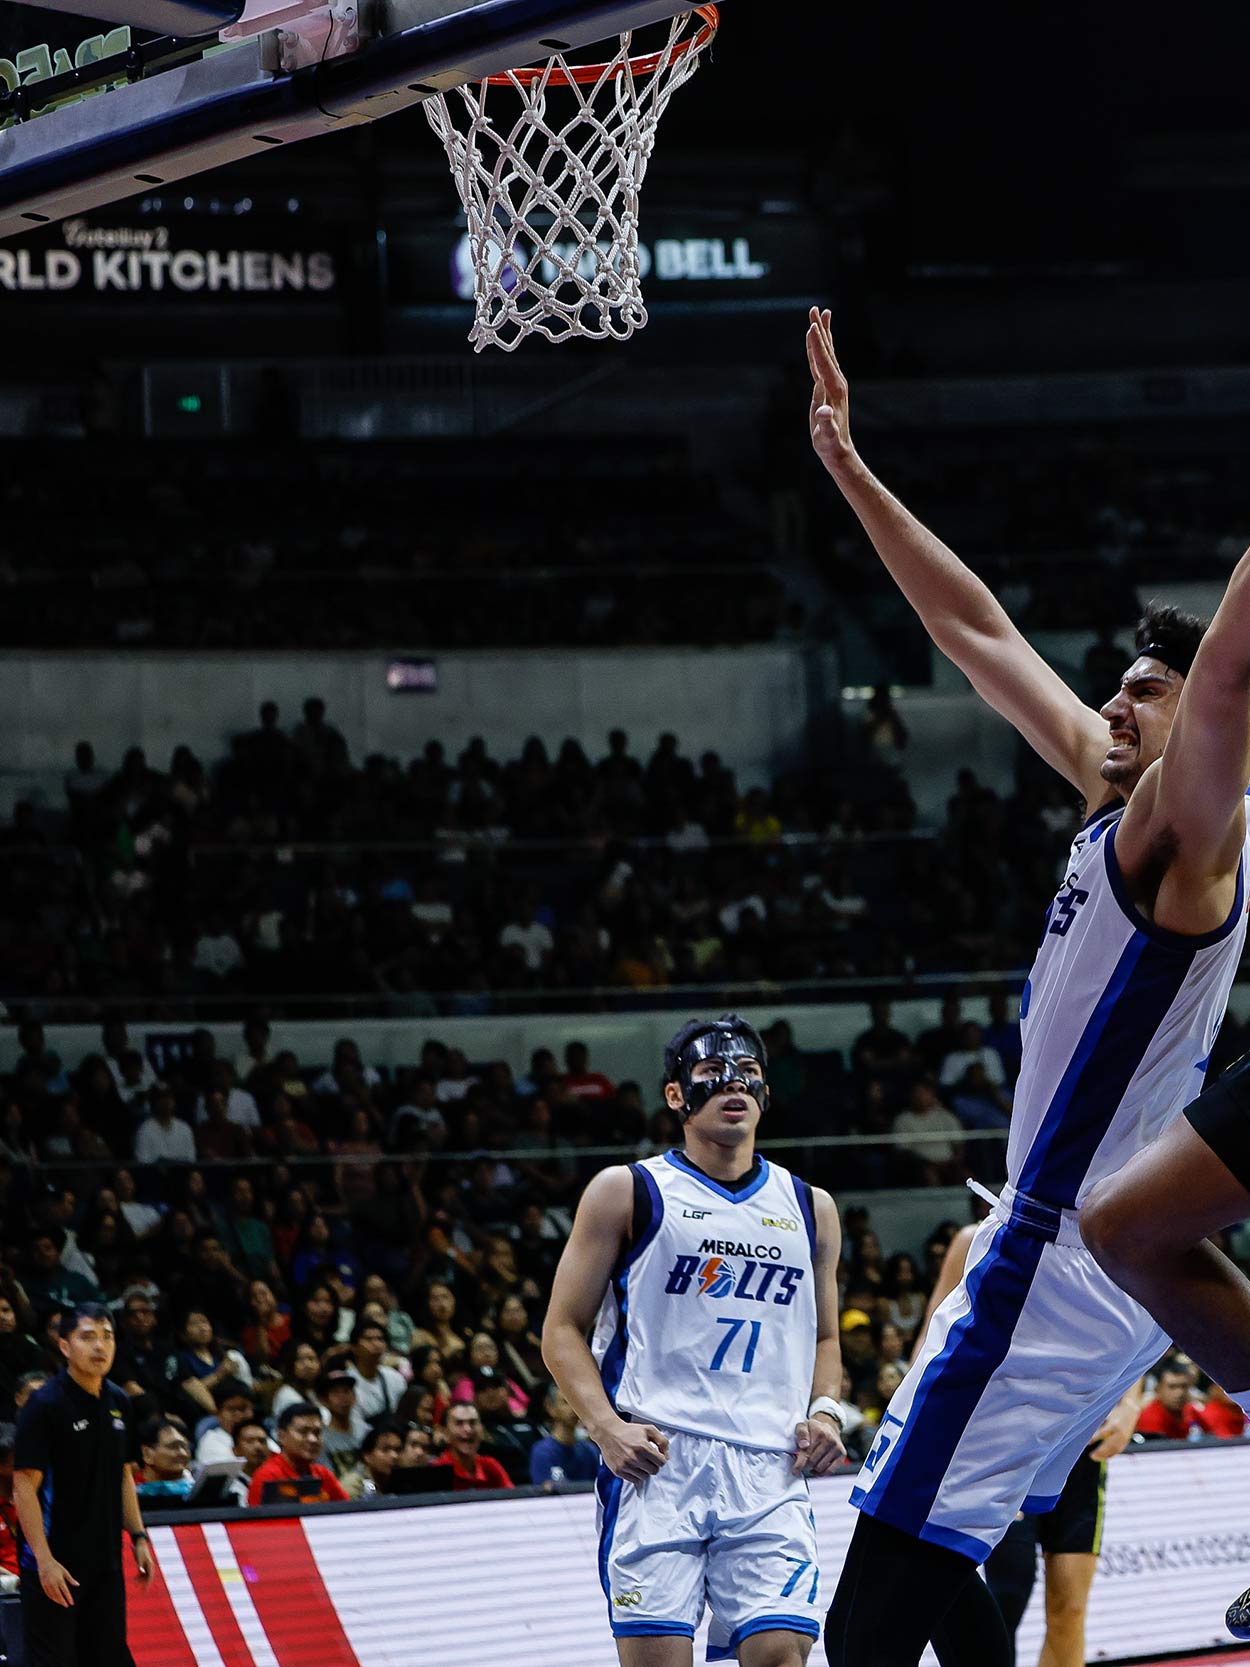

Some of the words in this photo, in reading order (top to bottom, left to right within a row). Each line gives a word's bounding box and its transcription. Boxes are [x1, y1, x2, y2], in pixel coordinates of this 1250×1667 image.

[93, 250, 336, 291] KITCHENS
[653, 238, 766, 280] BELL
[698, 1239, 782, 1260] MERALCO
[664, 1254, 805, 1306] BOLTS
[709, 1317, 762, 1373] 71
[779, 1556, 820, 1605] 71
